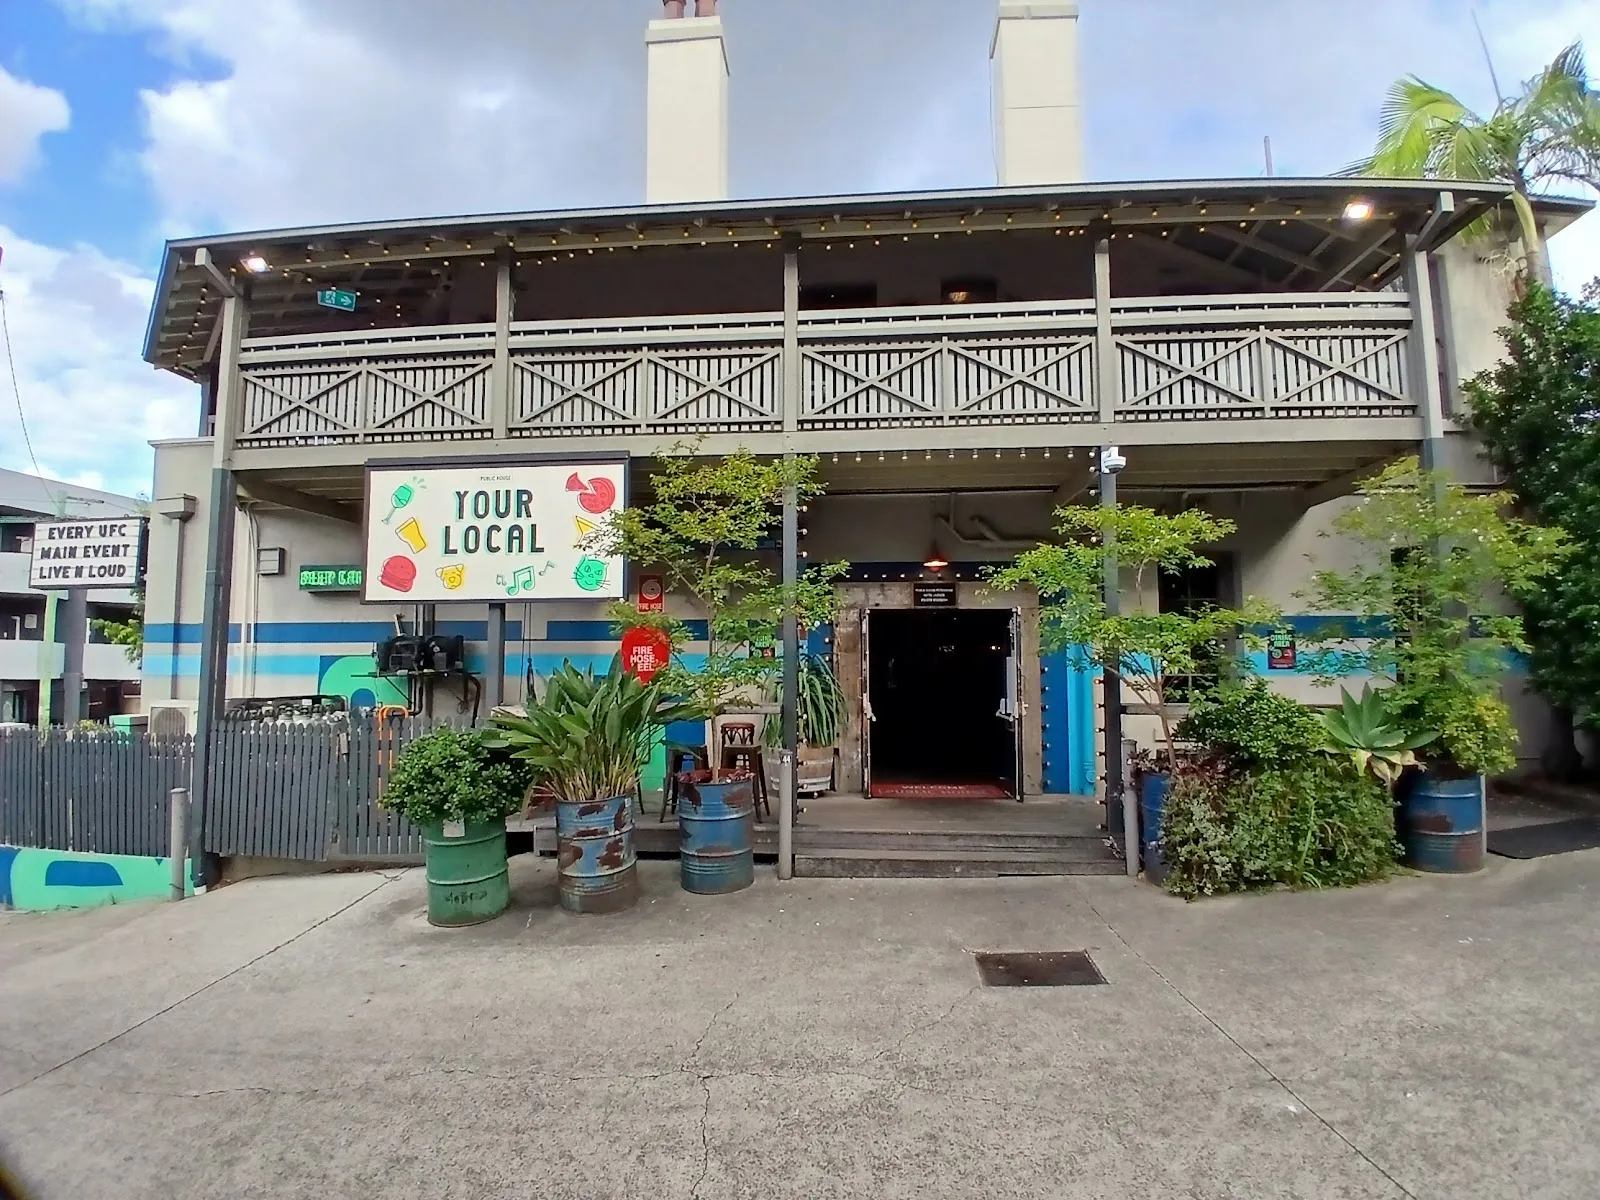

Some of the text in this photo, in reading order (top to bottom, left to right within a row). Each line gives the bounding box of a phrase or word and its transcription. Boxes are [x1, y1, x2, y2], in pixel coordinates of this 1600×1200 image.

[454, 489, 534, 521] YOUR
[48, 523, 127, 540] EVERY UFC
[442, 523, 545, 556] LOCAL
[40, 544, 130, 560] MAIN EVENT
[39, 564, 127, 580] LIVE N LOUD
[632, 645, 654, 655] FIRE
[629, 654, 656, 664] HOSE
